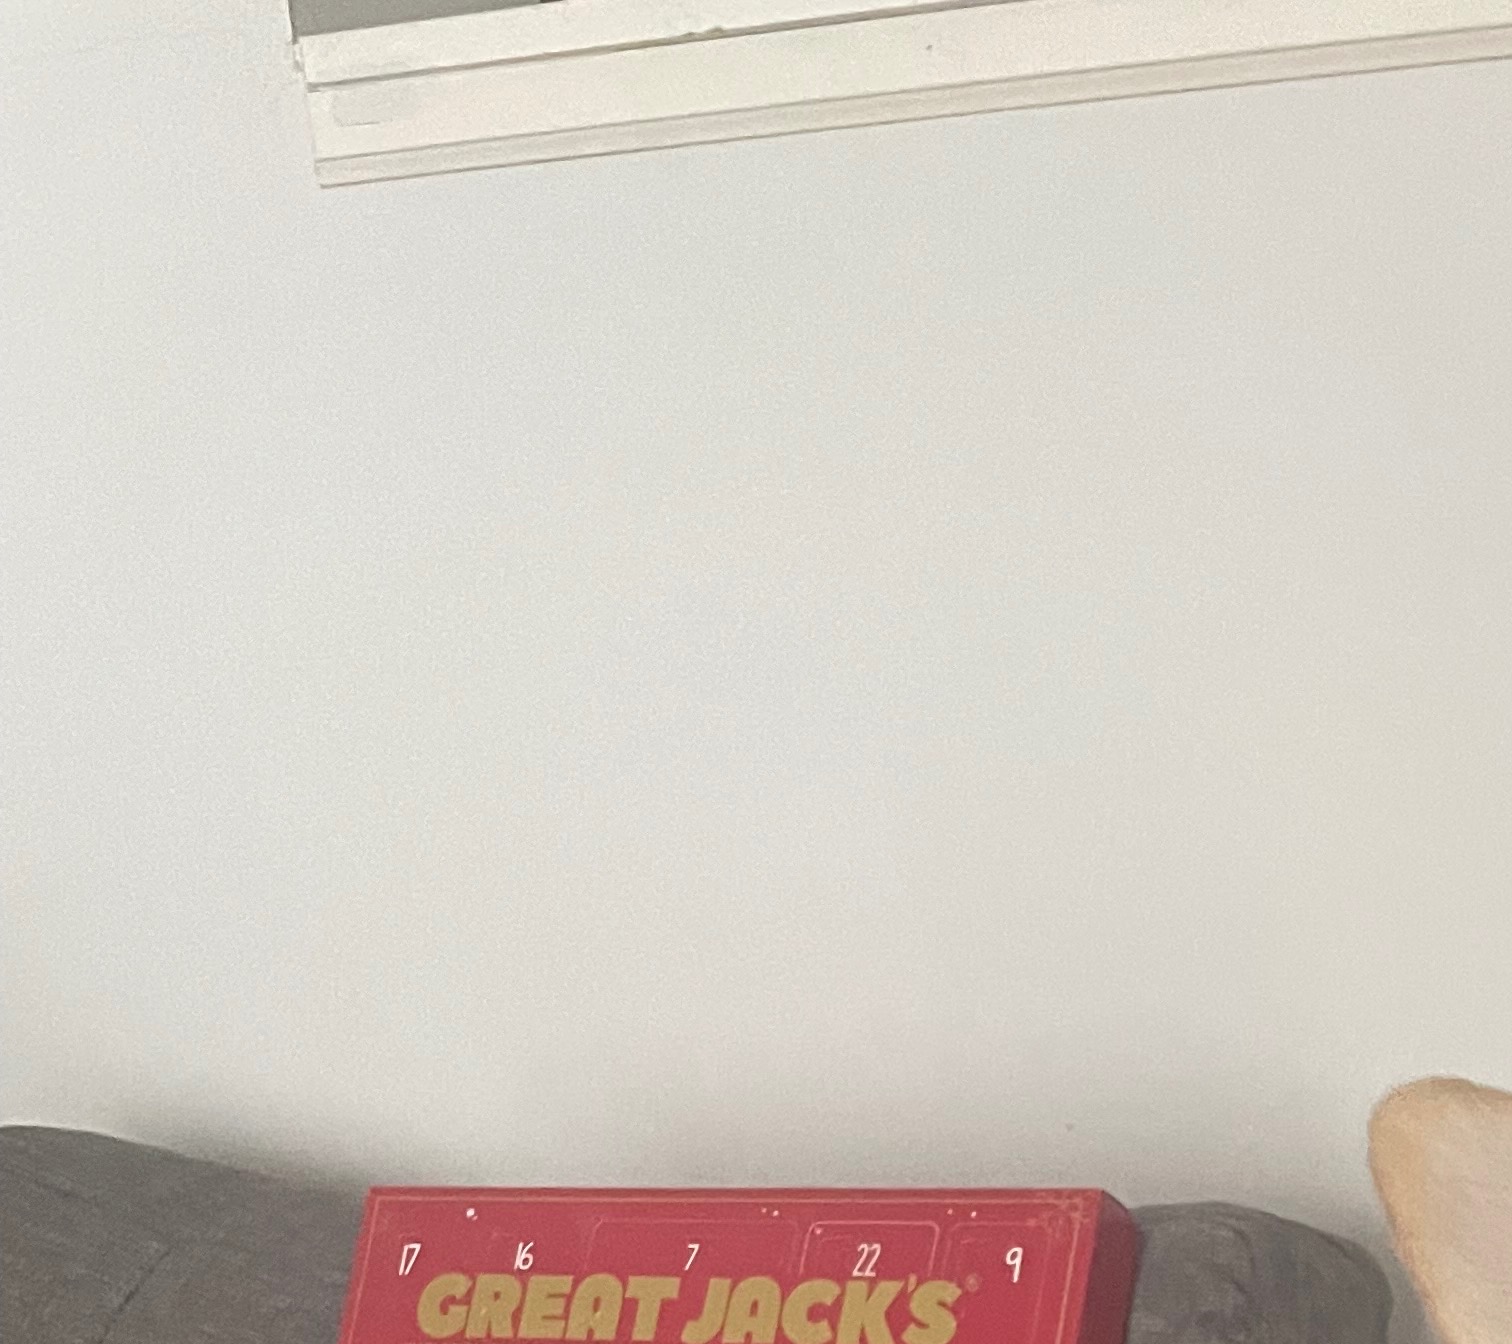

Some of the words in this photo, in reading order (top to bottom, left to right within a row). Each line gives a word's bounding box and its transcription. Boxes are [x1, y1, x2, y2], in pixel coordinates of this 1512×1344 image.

[399, 1243, 421, 1276] 17
[513, 1241, 534, 1271] 16
[684, 1243, 699, 1270] 7
[852, 1243, 881, 1277] 22
[1005, 1247, 1023, 1283] 9
[417, 1272, 682, 1341] GREAT
